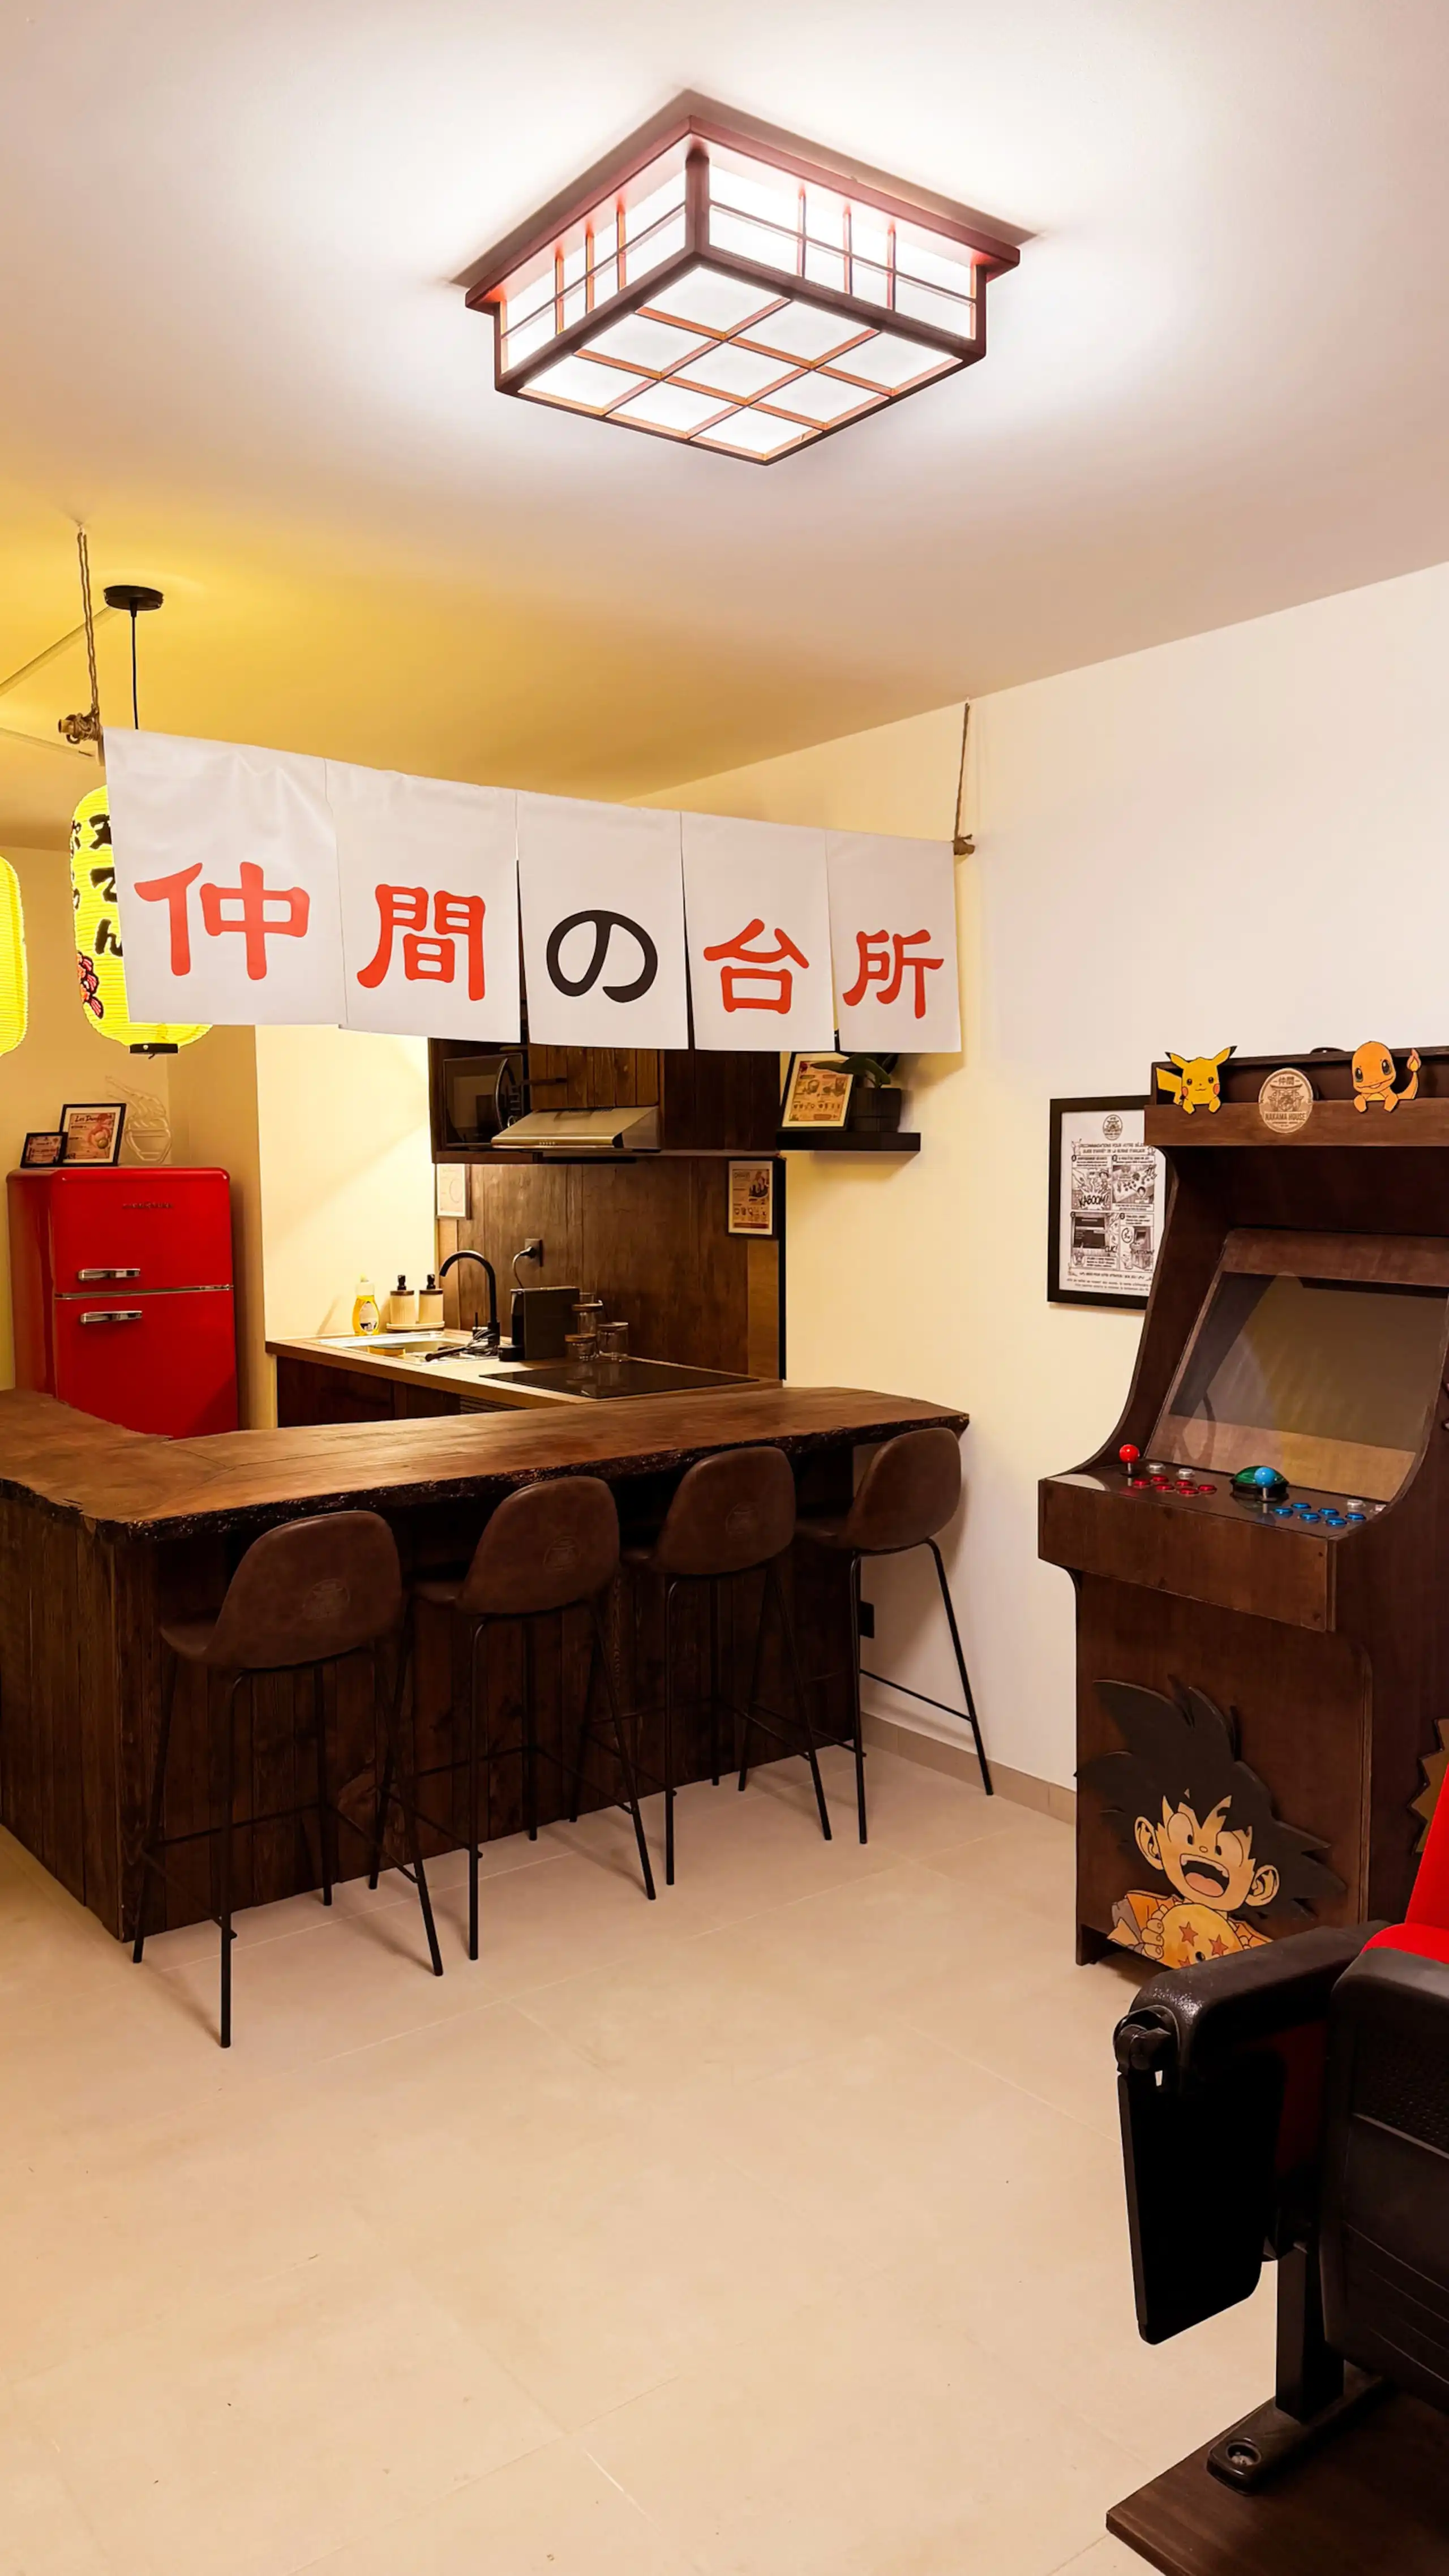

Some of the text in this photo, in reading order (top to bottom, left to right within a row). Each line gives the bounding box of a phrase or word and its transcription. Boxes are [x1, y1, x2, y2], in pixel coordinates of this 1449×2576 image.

[134, 861, 944, 1018] 仲間の台所
